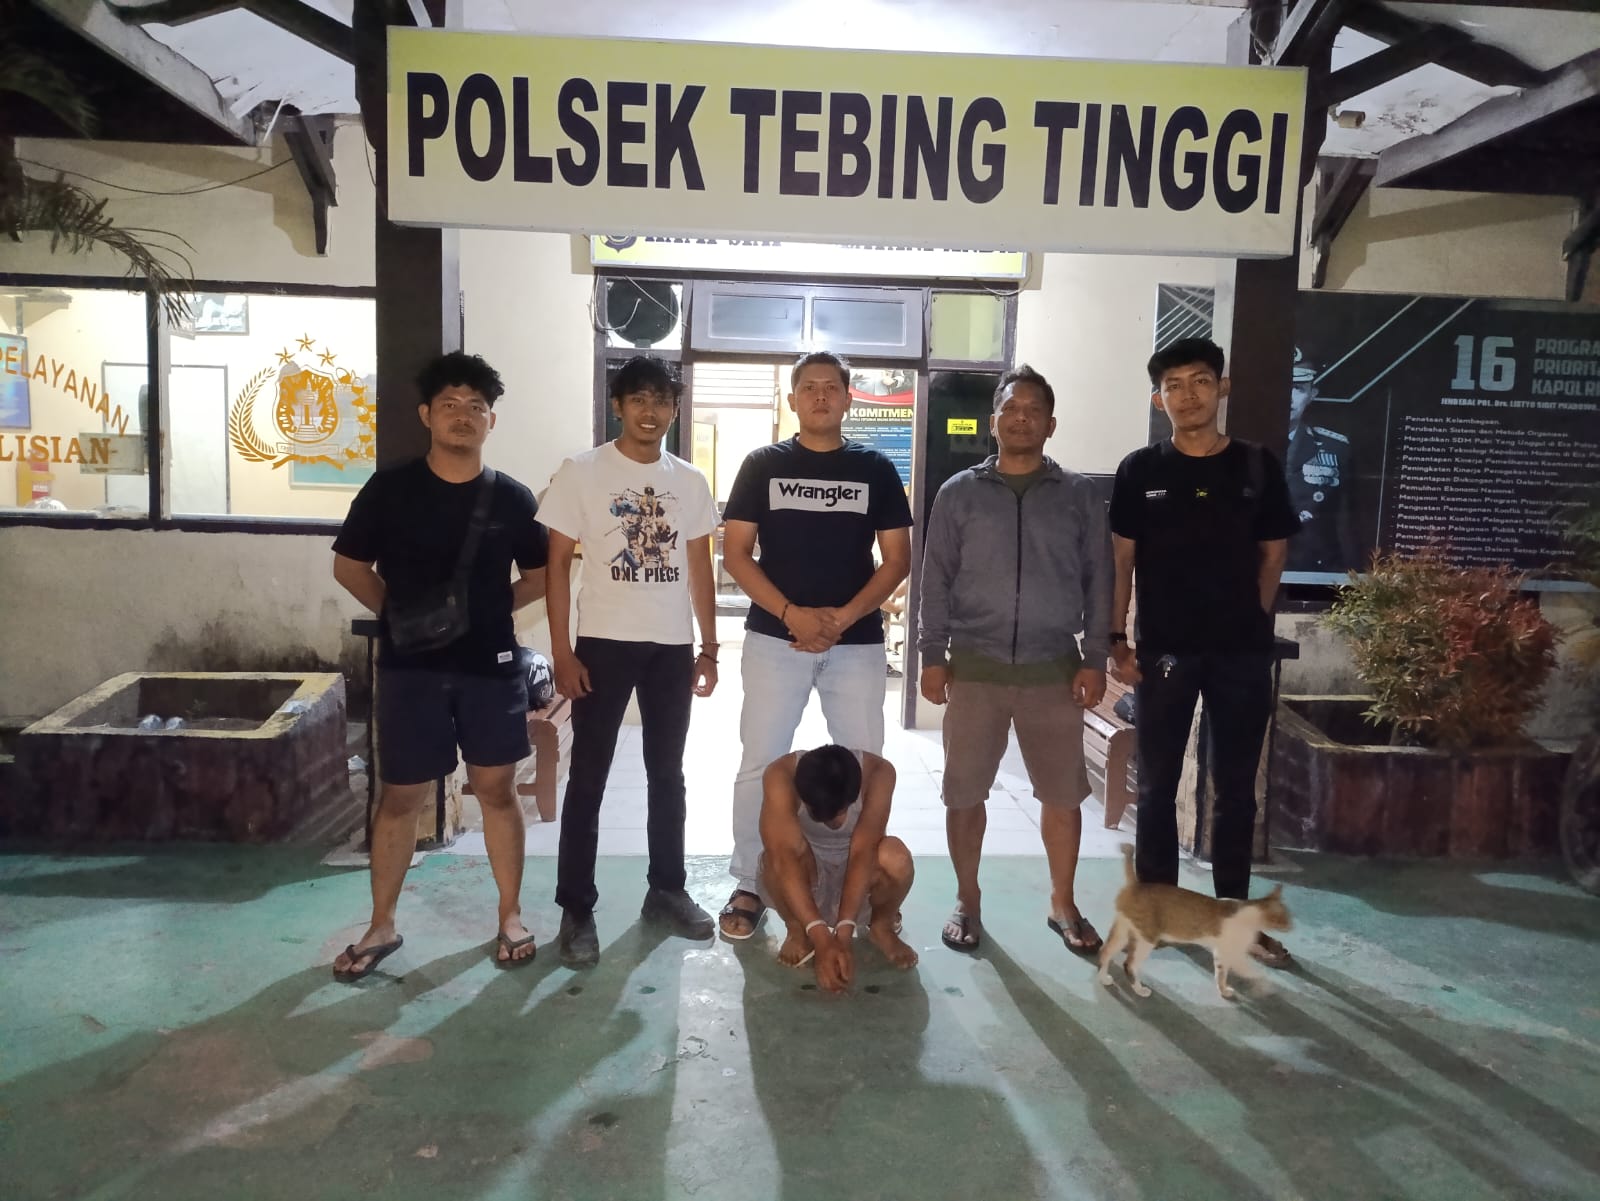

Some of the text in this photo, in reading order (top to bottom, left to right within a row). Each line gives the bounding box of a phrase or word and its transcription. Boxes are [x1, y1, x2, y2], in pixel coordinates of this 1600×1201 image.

[406, 71, 1289, 215] POLSEK TEBING TINGGI
[1450, 335, 1516, 392] 16
[0, 346, 129, 438] ELAYANAN
[1404, 425, 1448, 433] Perubahan
[1449, 426, 1476, 434] Sistem
[1404, 436, 1450, 444] Menjadikan
[1452, 436, 1472, 444] SDM
[1495, 438, 1516, 446] Yang
[1402, 444, 1446, 453] Perubahan
[1448, 446, 1487, 455] Teknologi
[1402, 454, 1452, 464] Pemantapan
[1401, 464, 1451, 473] Peningkatan
[1453, 466, 1481, 474] Kinerja
[1400, 474, 1451, 484] Pemantapan
[1400, 484, 1442, 492] Pemulihan
[778, 482, 862, 508] Wrangler
[1399, 494, 1438, 502] Menjamin
[1398, 504, 1441, 512] Penguatan
[1443, 505, 1492, 514] Penanganan
[1398, 514, 1447, 522] Peningkatan
[1483, 516, 1524, 524] Pelayanan
[1448, 524, 1490, 532] Pelayanan
[611, 565, 680, 583] ONE PIECE
